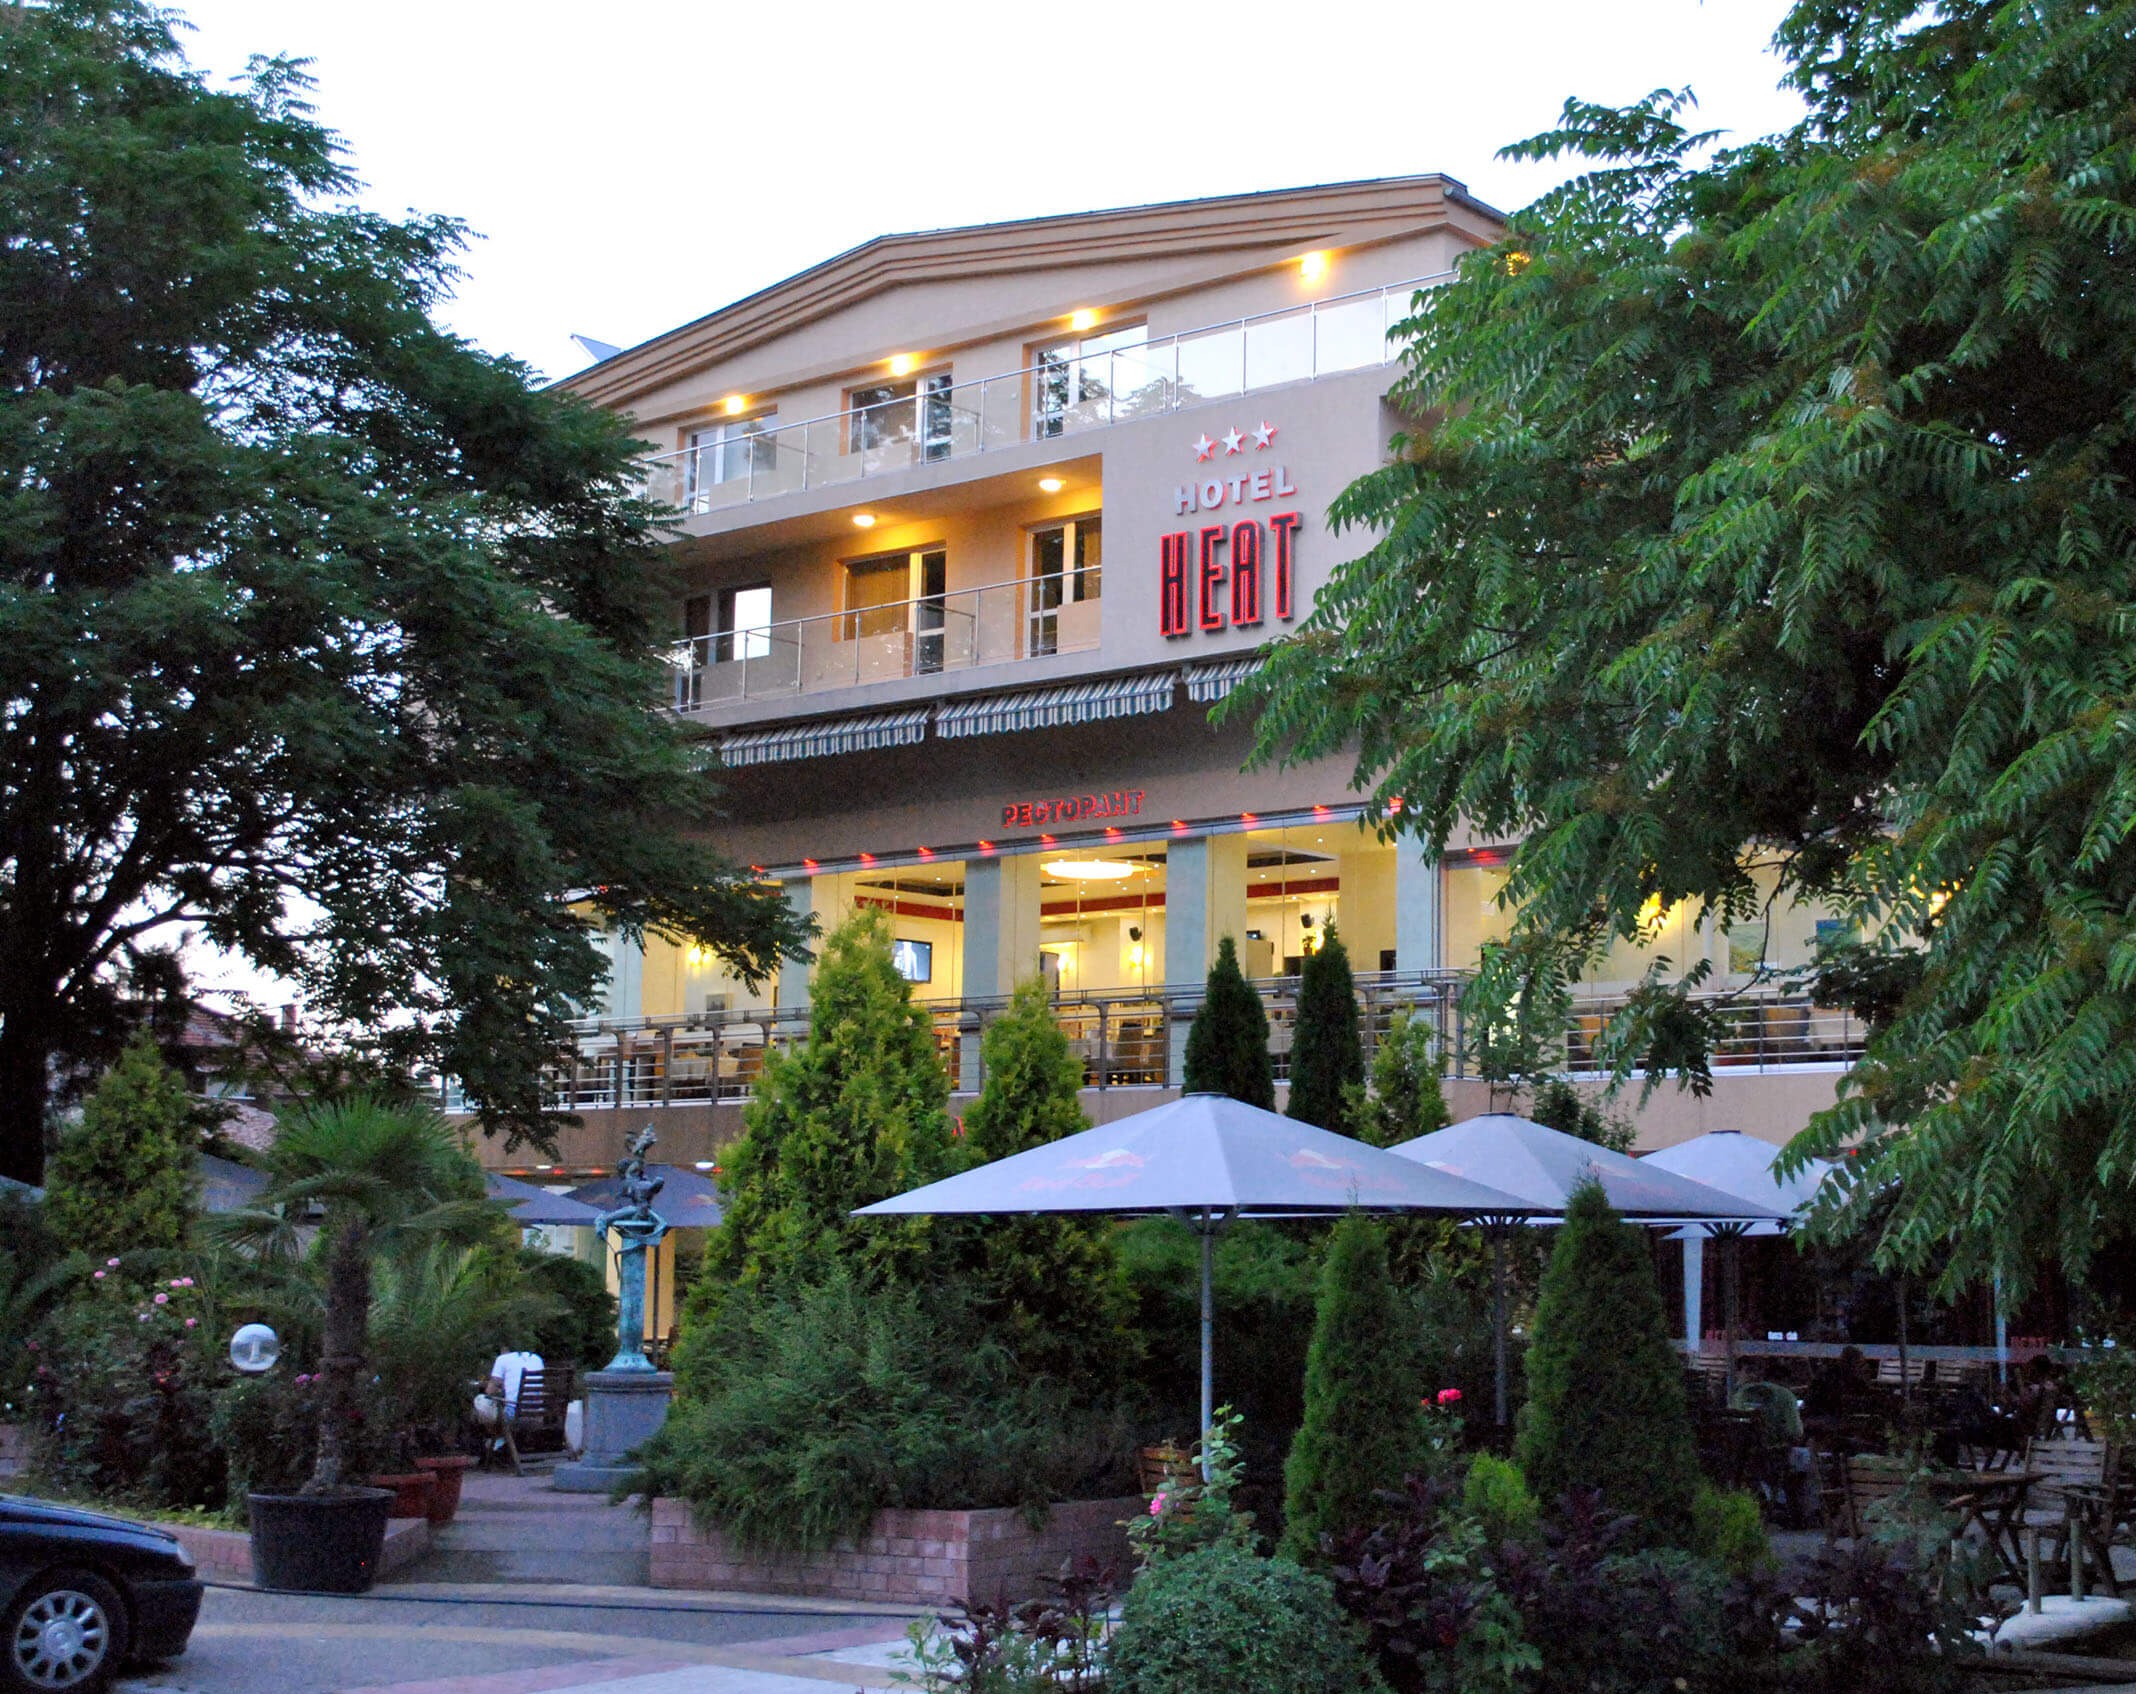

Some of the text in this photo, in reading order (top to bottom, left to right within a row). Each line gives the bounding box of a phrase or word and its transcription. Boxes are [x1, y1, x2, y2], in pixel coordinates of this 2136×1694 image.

[1175, 466, 1297, 515] HOTEL
[1160, 511, 1301, 638] HEAT
[1001, 790, 1145, 828] РЕСТОРАНТ
